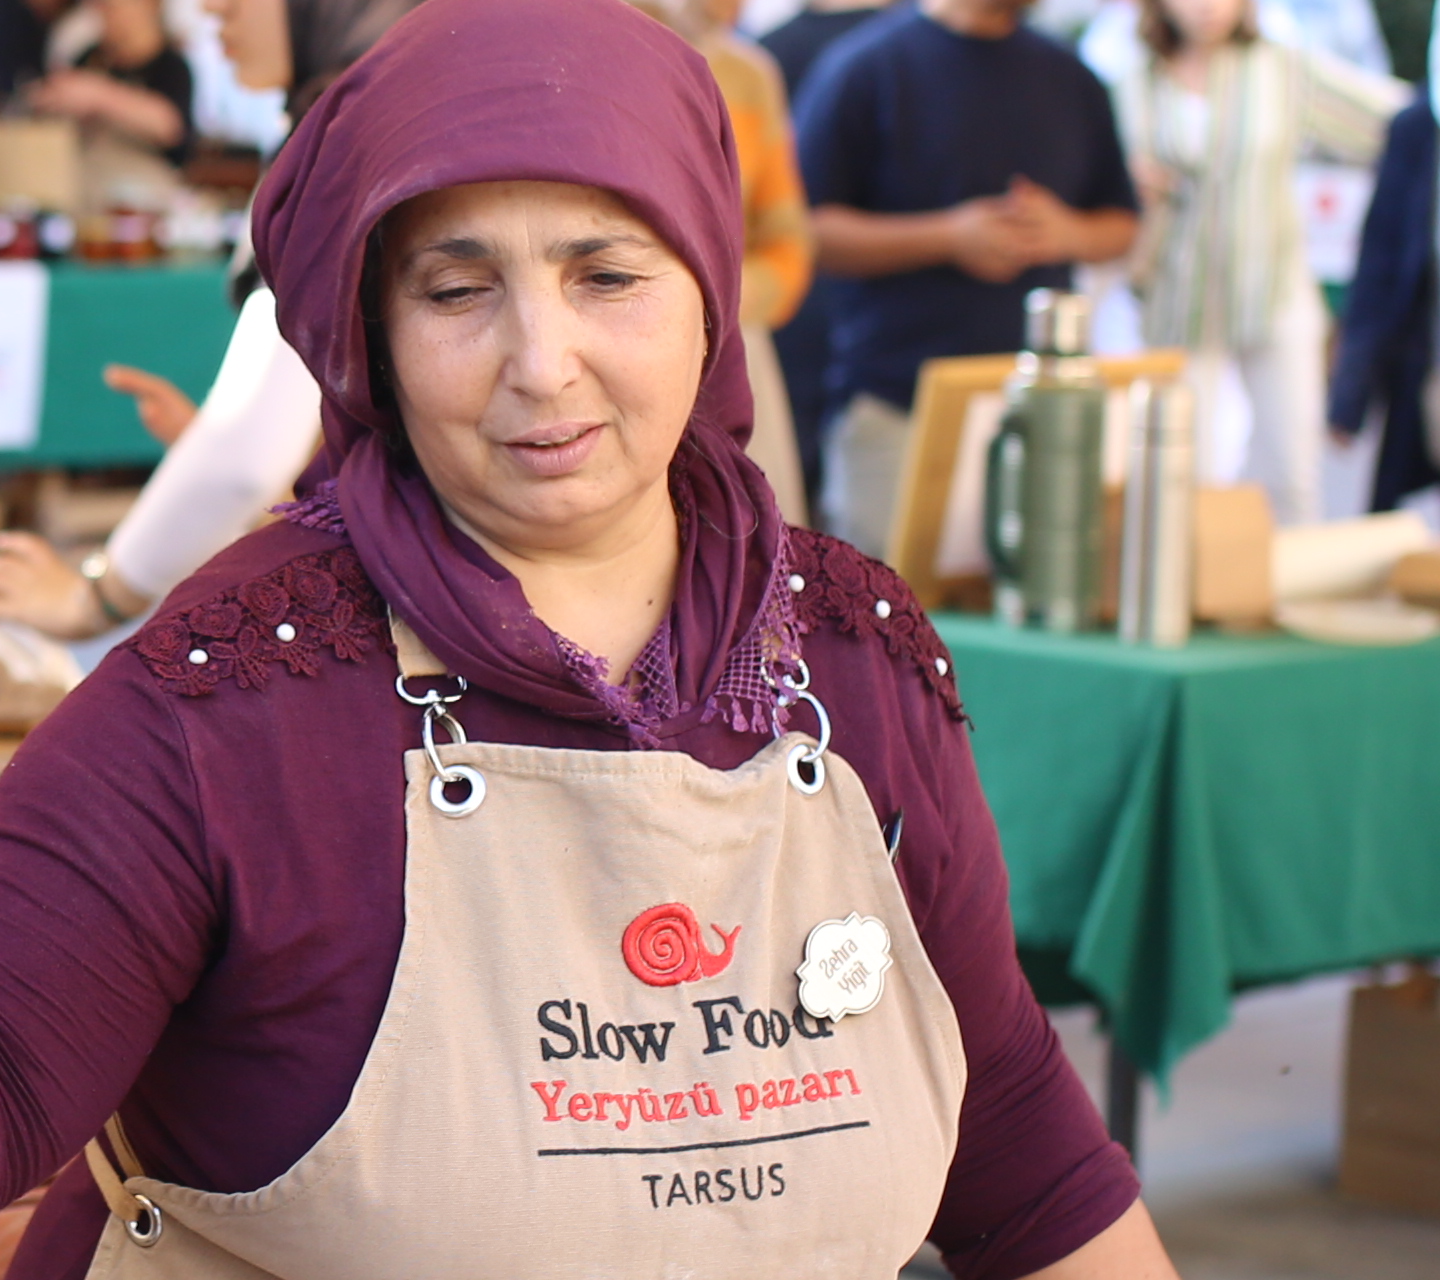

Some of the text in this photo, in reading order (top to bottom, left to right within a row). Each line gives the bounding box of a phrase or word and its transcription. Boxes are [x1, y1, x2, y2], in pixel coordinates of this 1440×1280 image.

[819, 938, 858, 979] Zehra
[537, 998, 676, 1063] Slow
[531, 1068, 863, 1131] Yeryüzü pazarı
[642, 1163, 787, 1209] TARSUS
